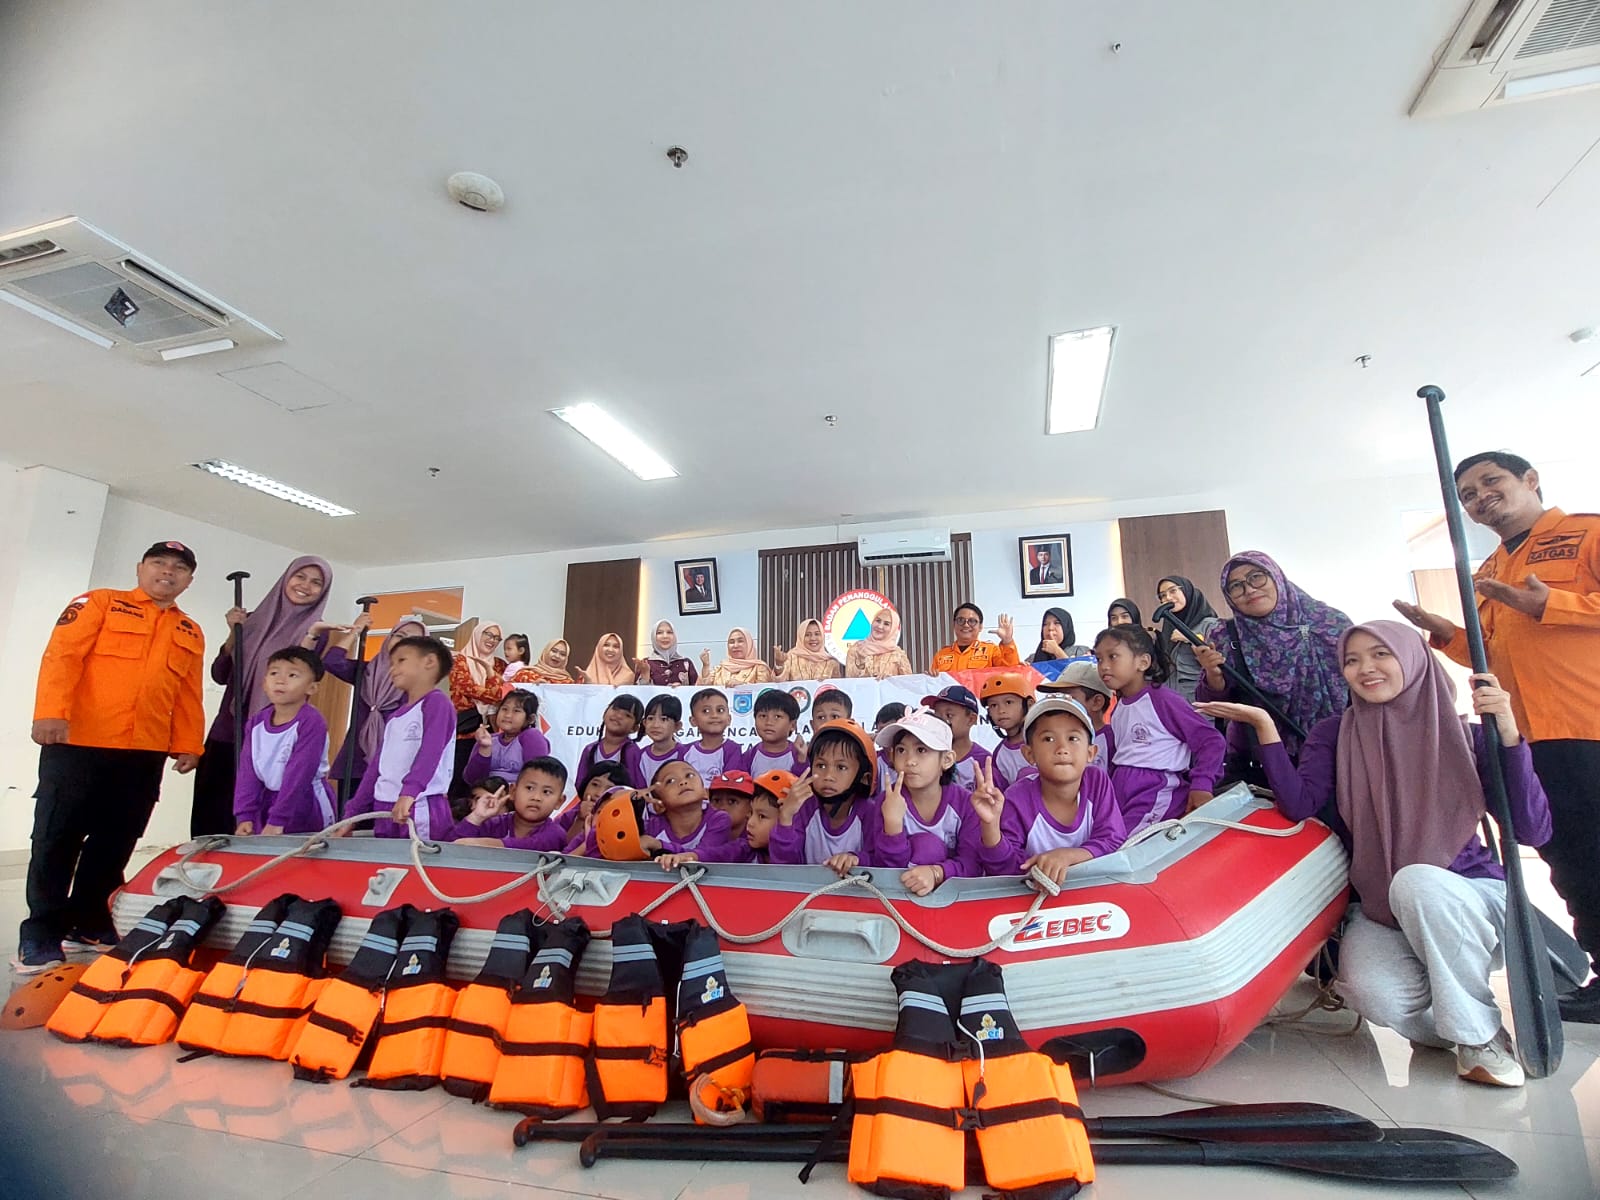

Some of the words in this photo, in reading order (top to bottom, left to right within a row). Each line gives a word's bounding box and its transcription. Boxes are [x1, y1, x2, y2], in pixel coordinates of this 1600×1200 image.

[1530, 548, 1575, 560] SATGAS
[824, 604, 840, 630] BADAN
[838, 591, 890, 610] PENANGGULA
[567, 725, 602, 737] EDUK
[1009, 914, 1111, 943] ZEBEC
[977, 1027, 1004, 1040] meri
